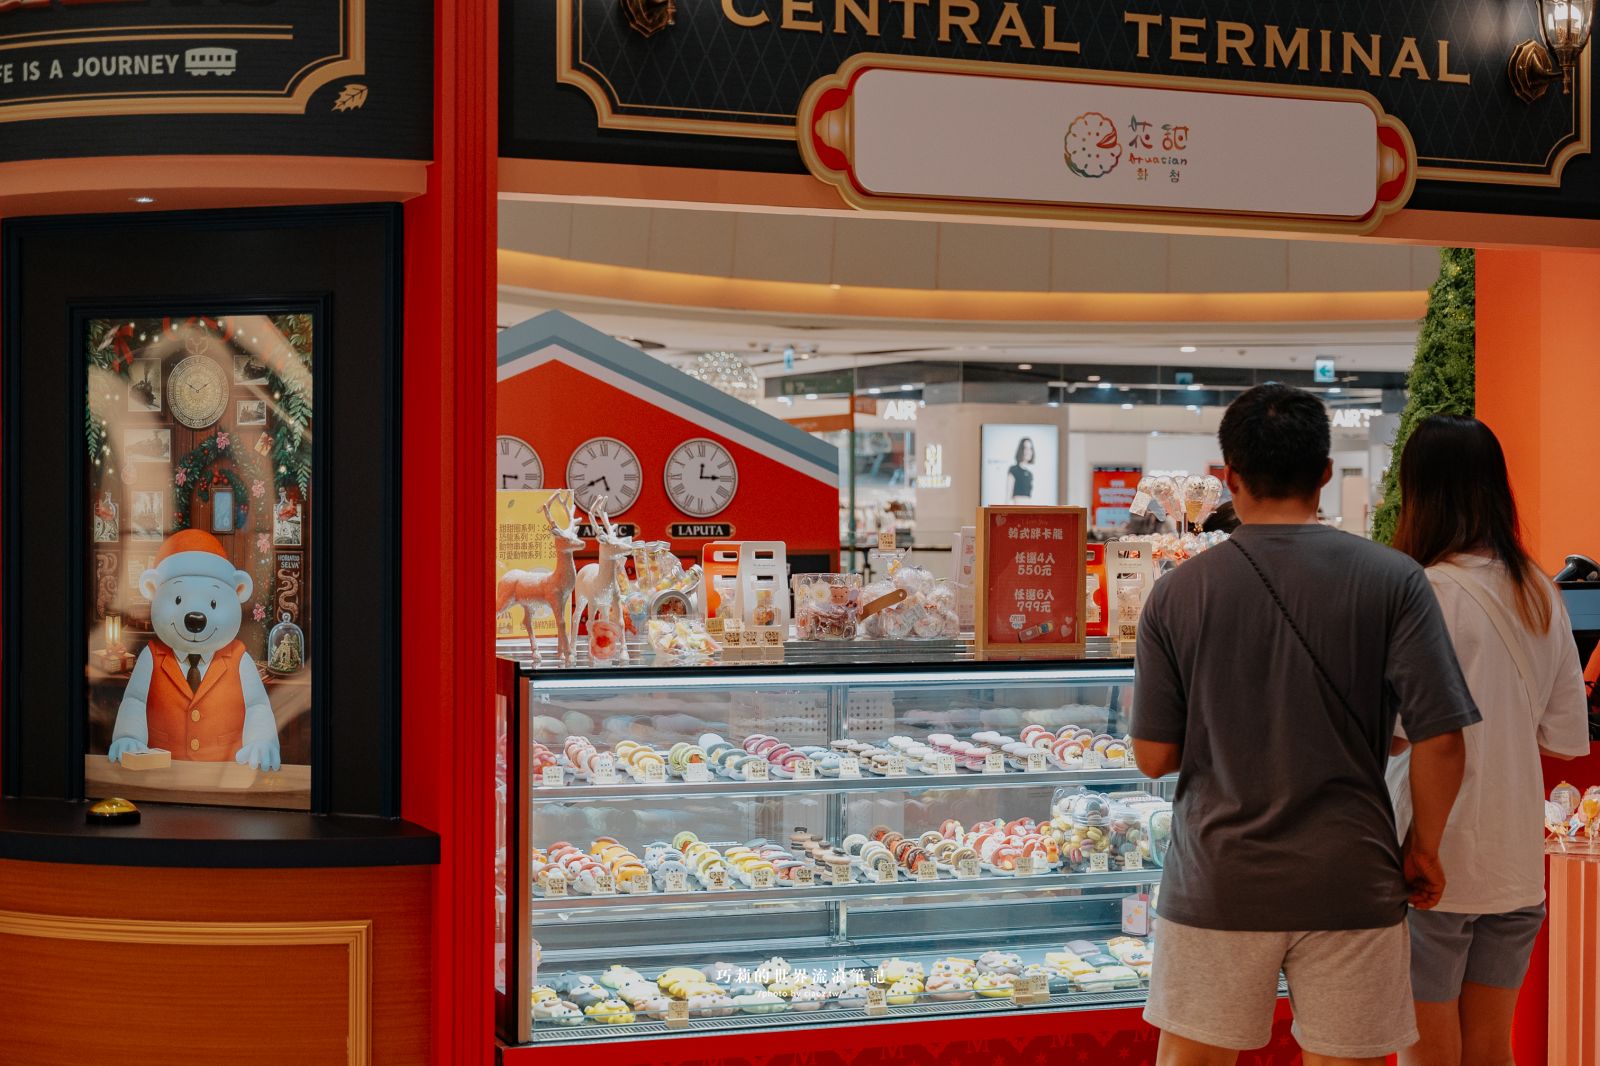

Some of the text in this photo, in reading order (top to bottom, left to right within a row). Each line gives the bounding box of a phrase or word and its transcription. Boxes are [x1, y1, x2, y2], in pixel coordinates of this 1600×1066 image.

[721, 0, 1471, 85] CENTRAL TERMINAL
[22, 61, 41, 81] IS
[49, 59, 63, 79] A
[72, 54, 180, 78] JOURNEY
[678, 525, 724, 536] LAPUTA
[1017, 565, 1052, 577] 550元
[1016, 601, 1052, 613] 799元
